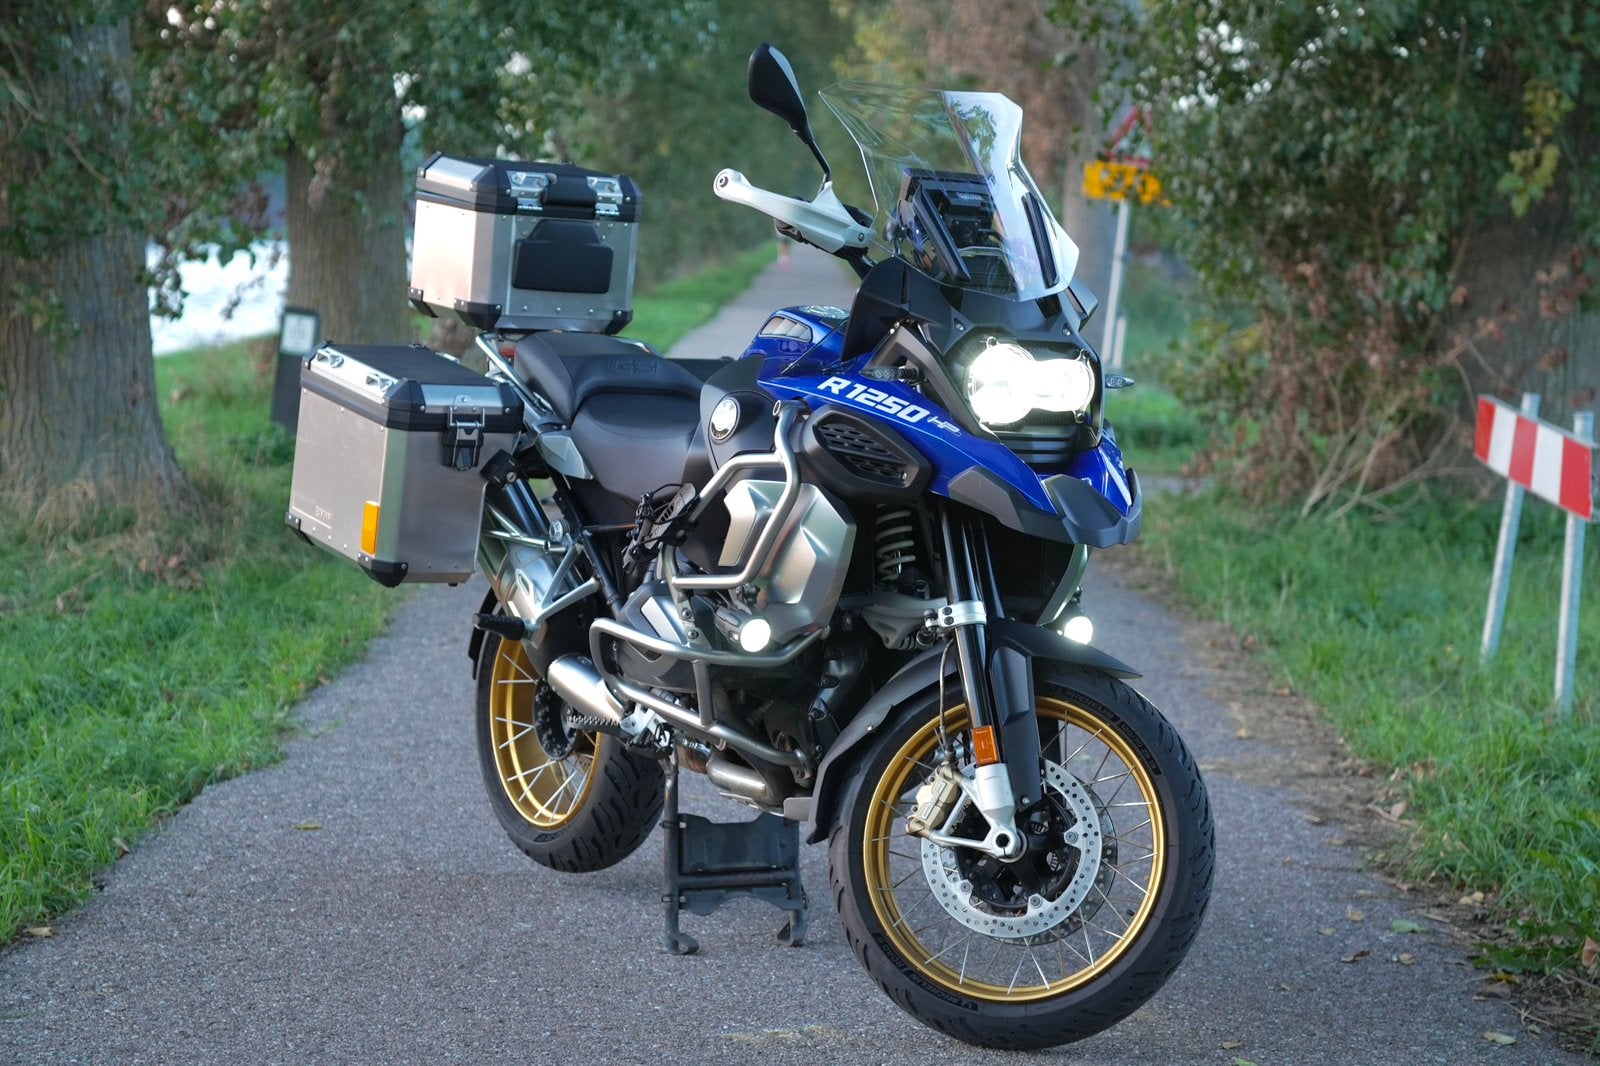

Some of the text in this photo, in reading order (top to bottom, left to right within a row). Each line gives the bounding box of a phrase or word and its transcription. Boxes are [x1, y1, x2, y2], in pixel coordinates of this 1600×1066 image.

[817, 376, 851, 395] R
[845, 383, 930, 423] 1250
[1064, 690, 1115, 719] MICHELIN
[881, 943, 905, 968] ROAD
[909, 972, 960, 1003] MICHELIN
